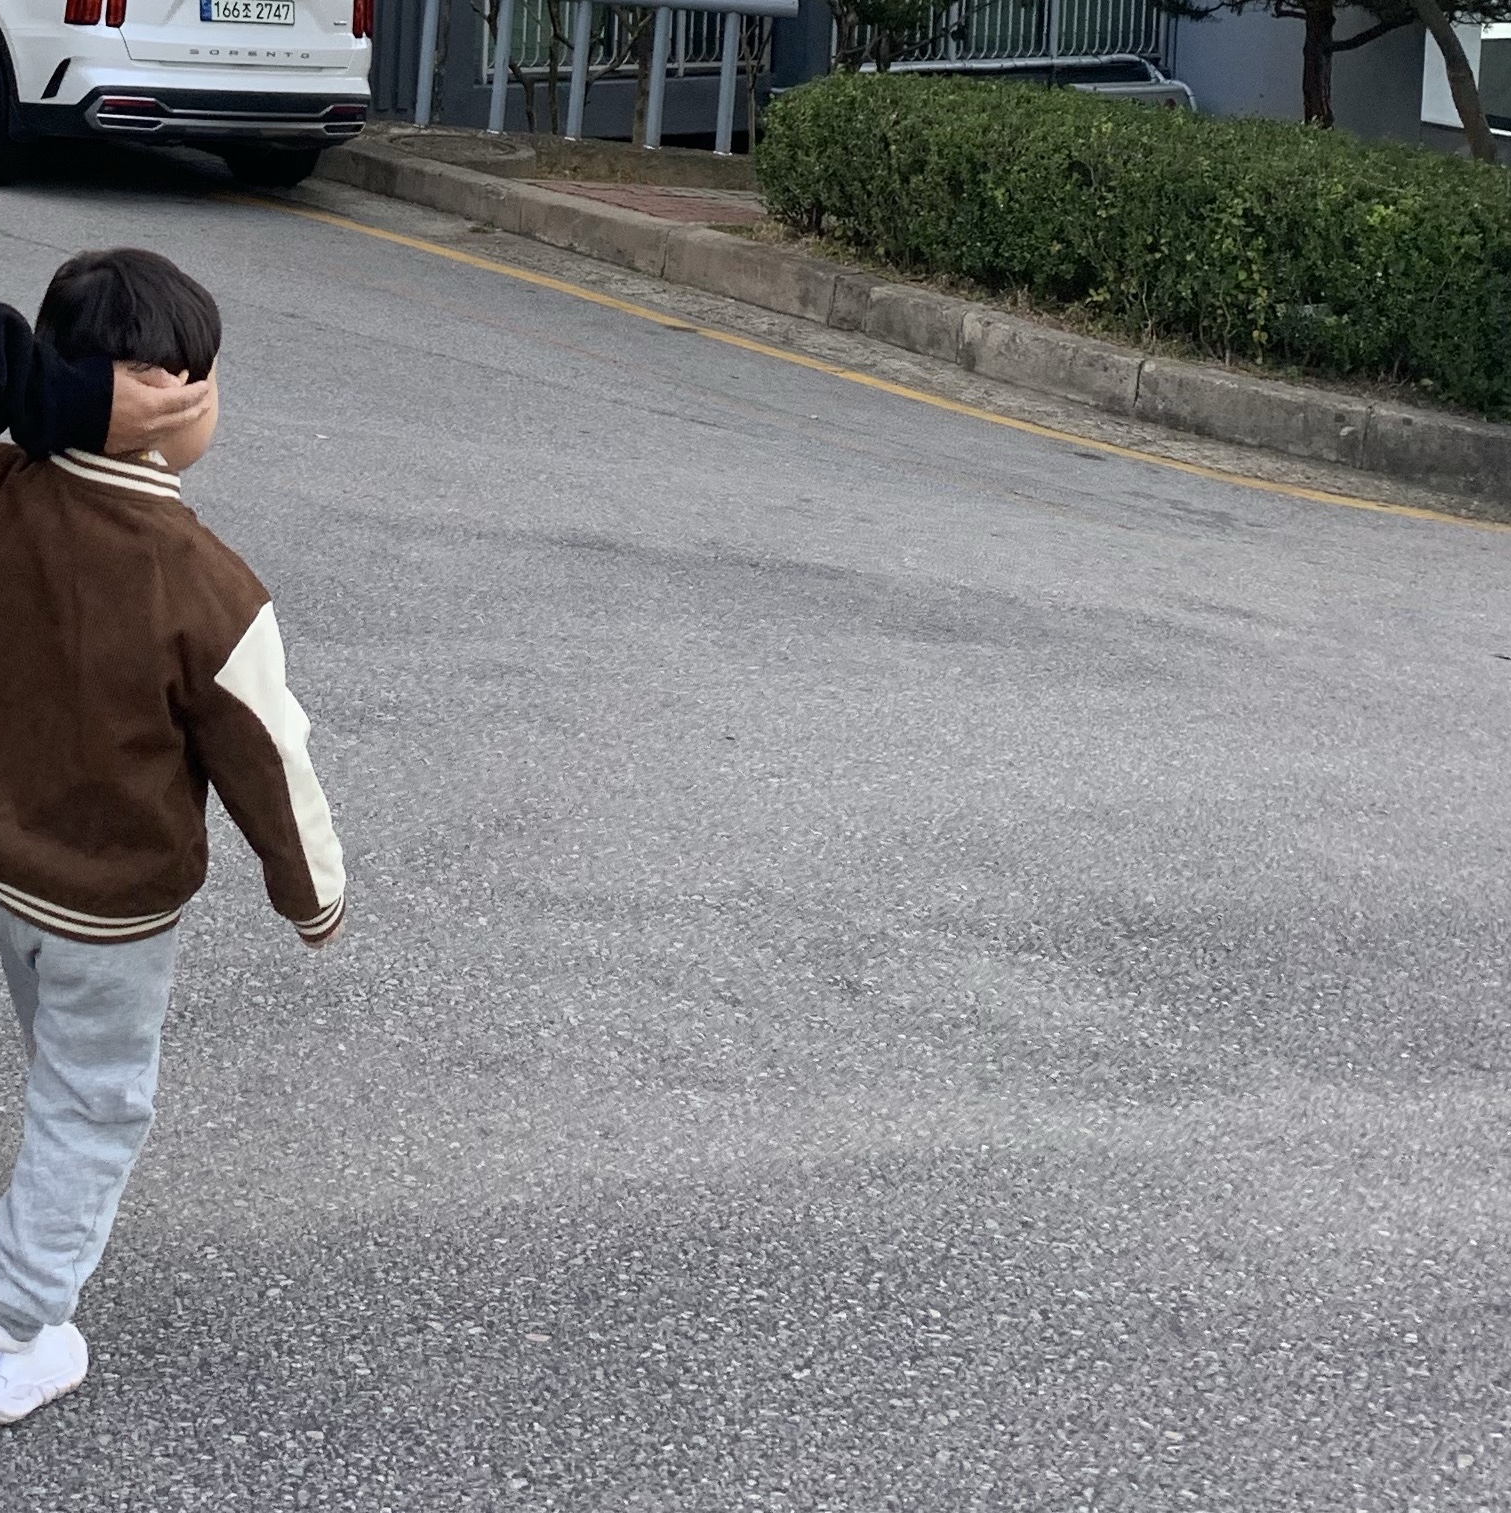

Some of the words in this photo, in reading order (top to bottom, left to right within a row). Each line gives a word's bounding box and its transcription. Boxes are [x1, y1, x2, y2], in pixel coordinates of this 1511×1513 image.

[214, 1, 252, 19] 166조
[256, 2, 290, 21] 2747
[189, 48, 310, 59] SORENTO
